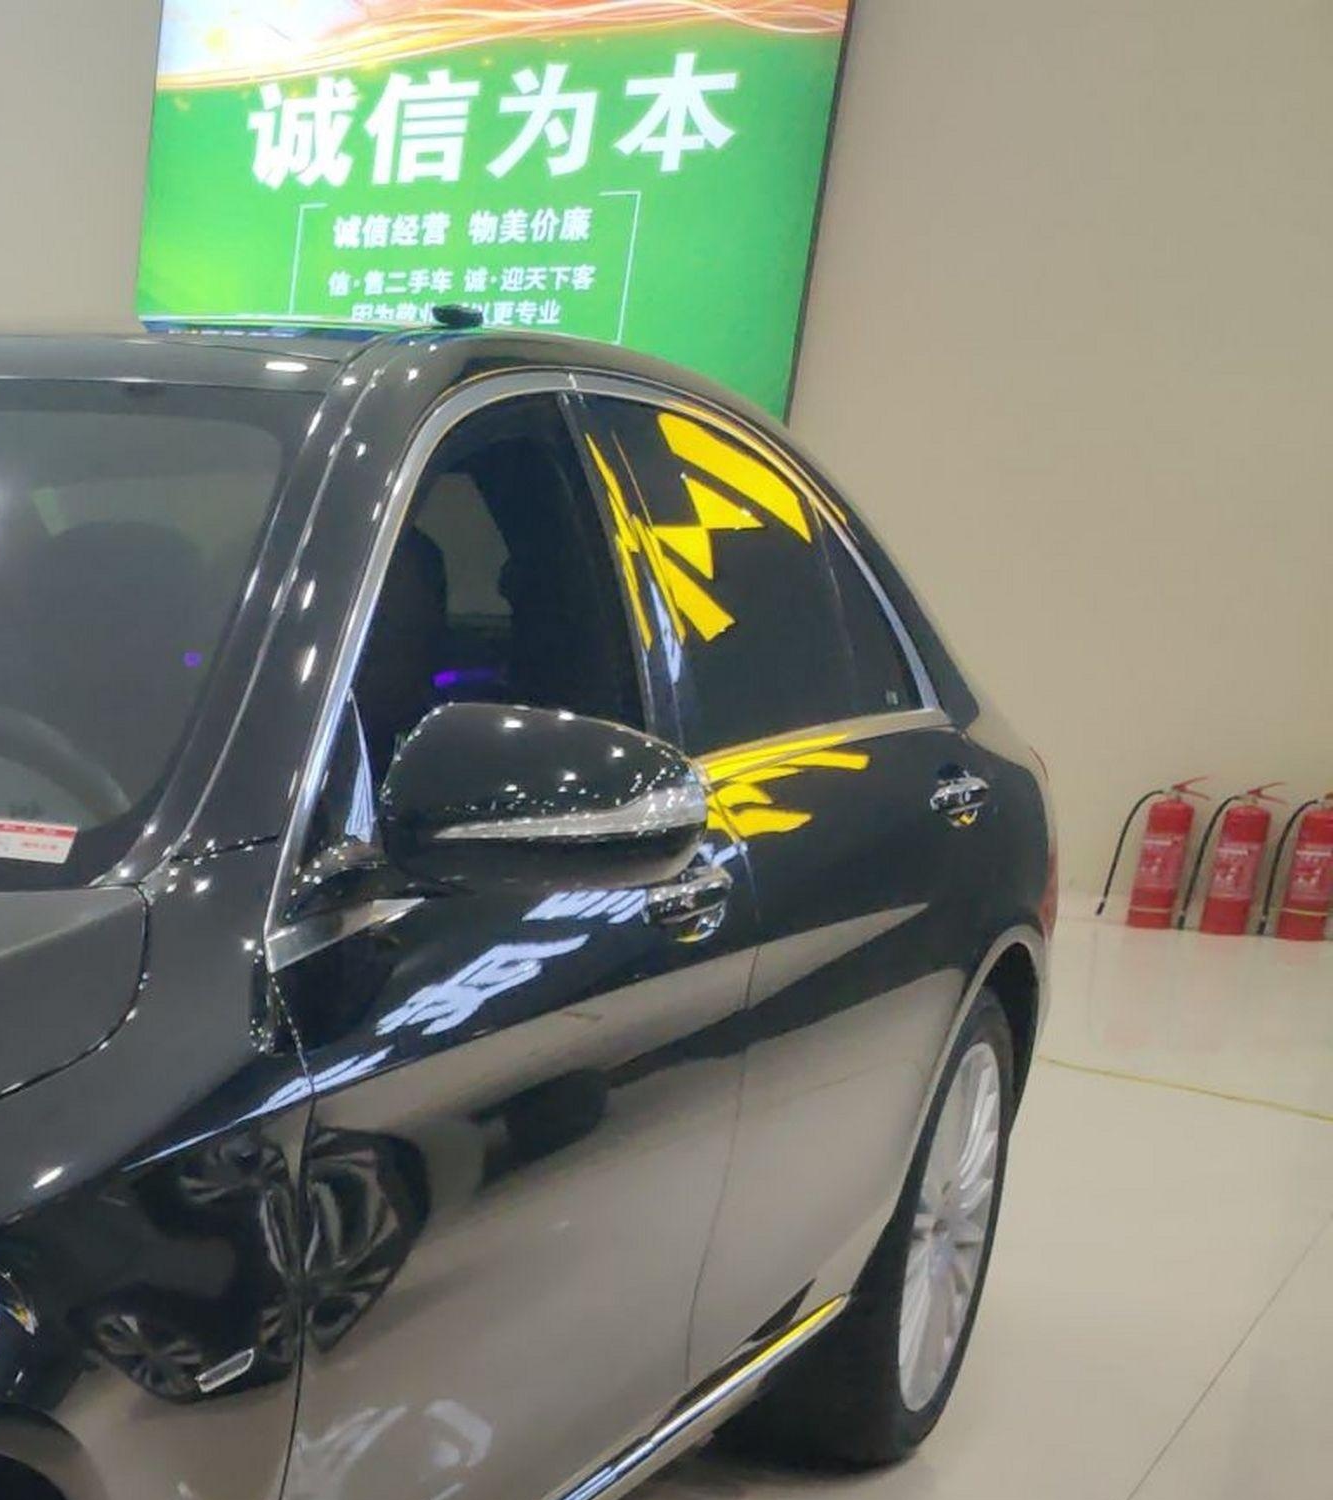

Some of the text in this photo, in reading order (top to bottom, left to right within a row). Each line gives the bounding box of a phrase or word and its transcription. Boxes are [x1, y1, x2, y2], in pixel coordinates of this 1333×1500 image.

[247, 52, 737, 190] 诚信为本
[333, 206, 593, 249] 诚信经营 物美价廉
